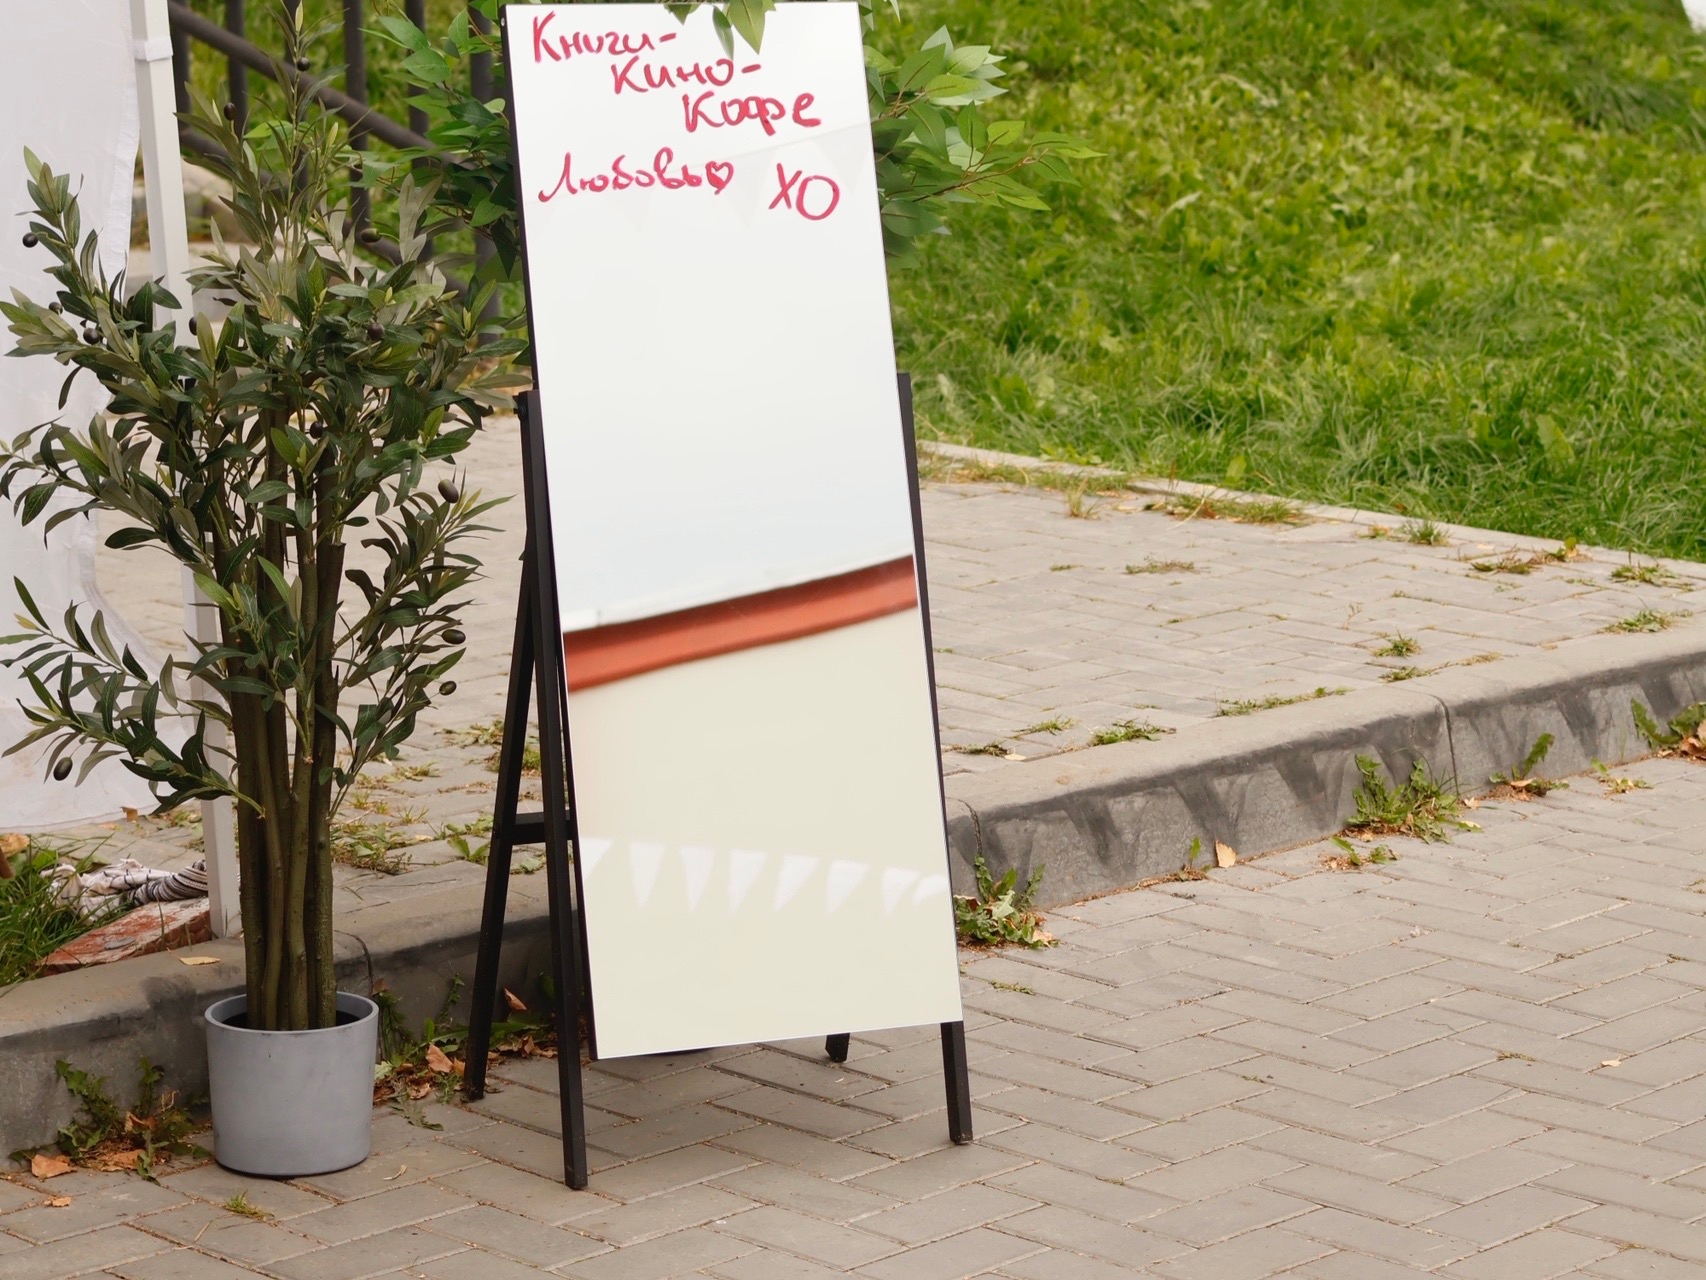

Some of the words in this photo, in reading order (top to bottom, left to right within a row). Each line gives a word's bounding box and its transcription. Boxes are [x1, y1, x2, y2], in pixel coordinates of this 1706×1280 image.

[532, 10, 678, 64] Книги-
[610, 54, 762, 95] Кино-
[681, 89, 822, 137] Кофе
